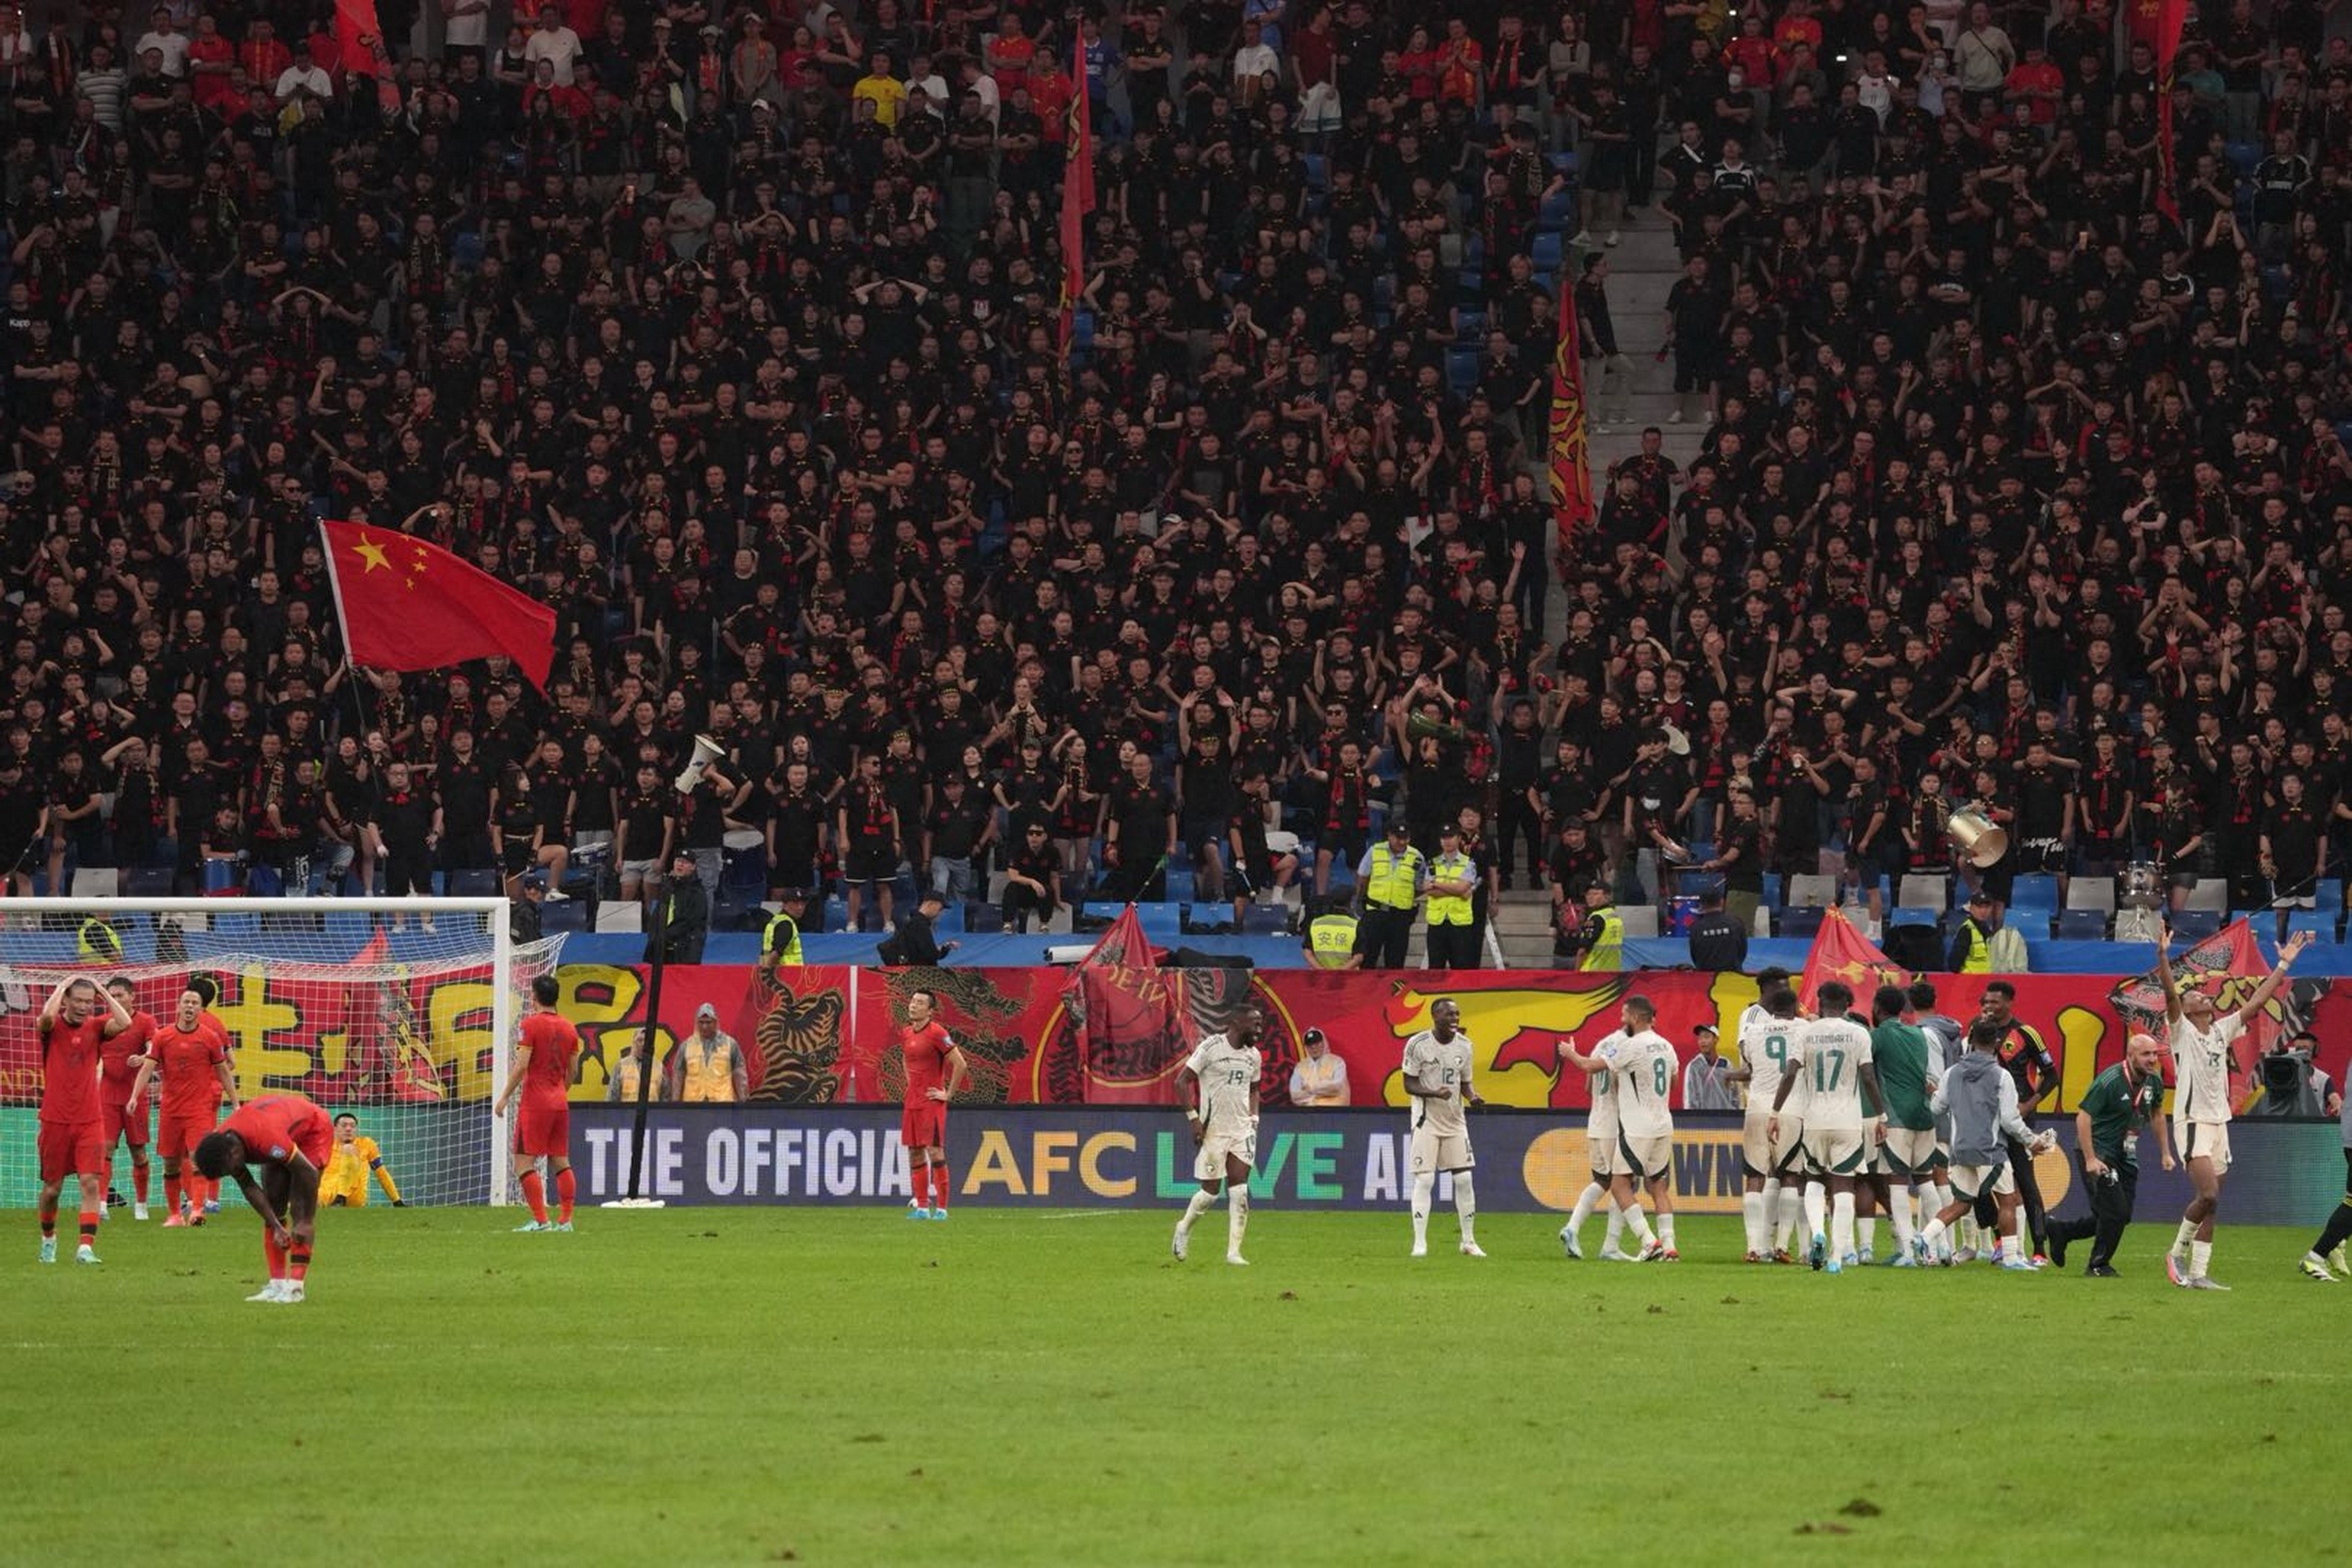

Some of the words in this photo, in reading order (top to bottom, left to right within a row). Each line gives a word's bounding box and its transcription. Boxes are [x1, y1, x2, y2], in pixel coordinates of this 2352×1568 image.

[1318, 931, 1348, 947] 安保
[1765, 1036, 1787, 1074] 9
[1816, 1049, 1845, 1092] 17
[1228, 1070, 1244, 1086] 19
[1442, 1067, 1455, 1085] 12
[1654, 1058, 1666, 1097] 8
[585, 1129, 683, 1196] THE
[706, 1127, 937, 1196] OFFICIA
[961, 1130, 1138, 1199] AFC
[1156, 1132, 1344, 1200] LVE
